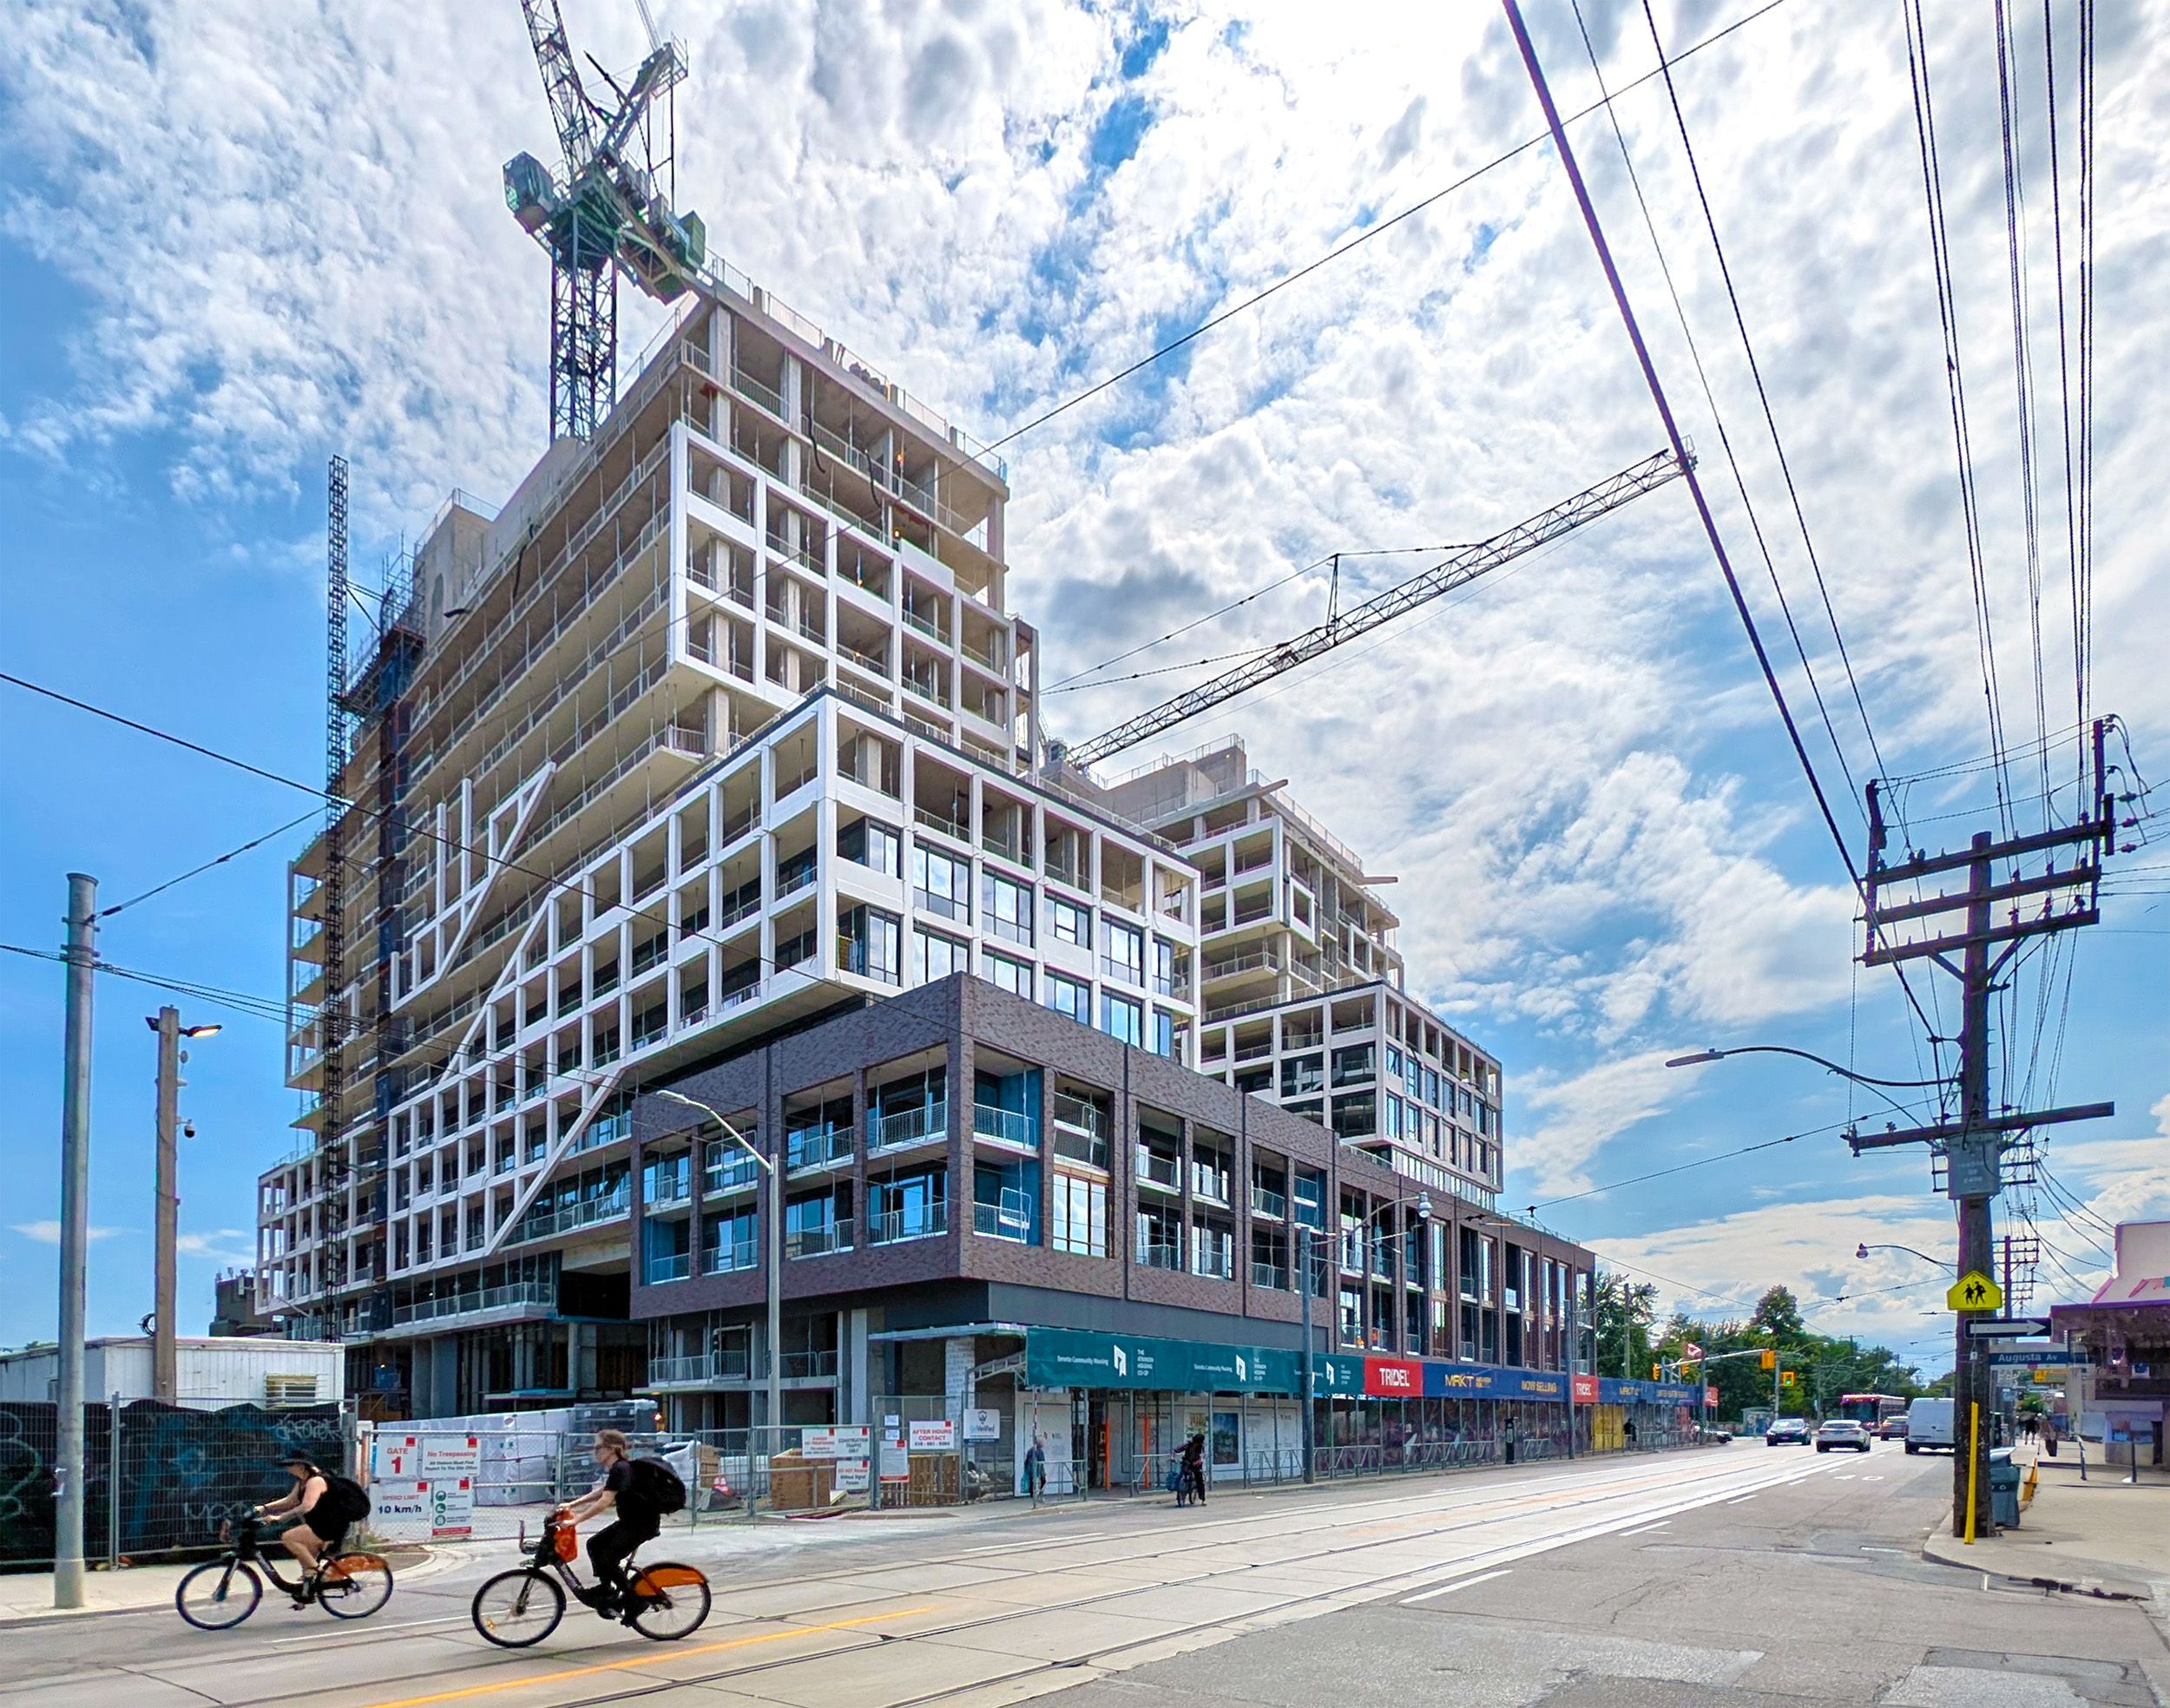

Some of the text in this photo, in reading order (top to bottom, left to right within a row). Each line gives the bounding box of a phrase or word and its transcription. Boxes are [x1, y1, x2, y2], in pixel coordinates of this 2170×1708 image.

[1998, 1353, 2042, 1363] Augusta
[1378, 1368, 1410, 1387] TRIDEL
[391, 1456, 401, 1474] 1
[378, 1504, 422, 1514] 10 km/h
